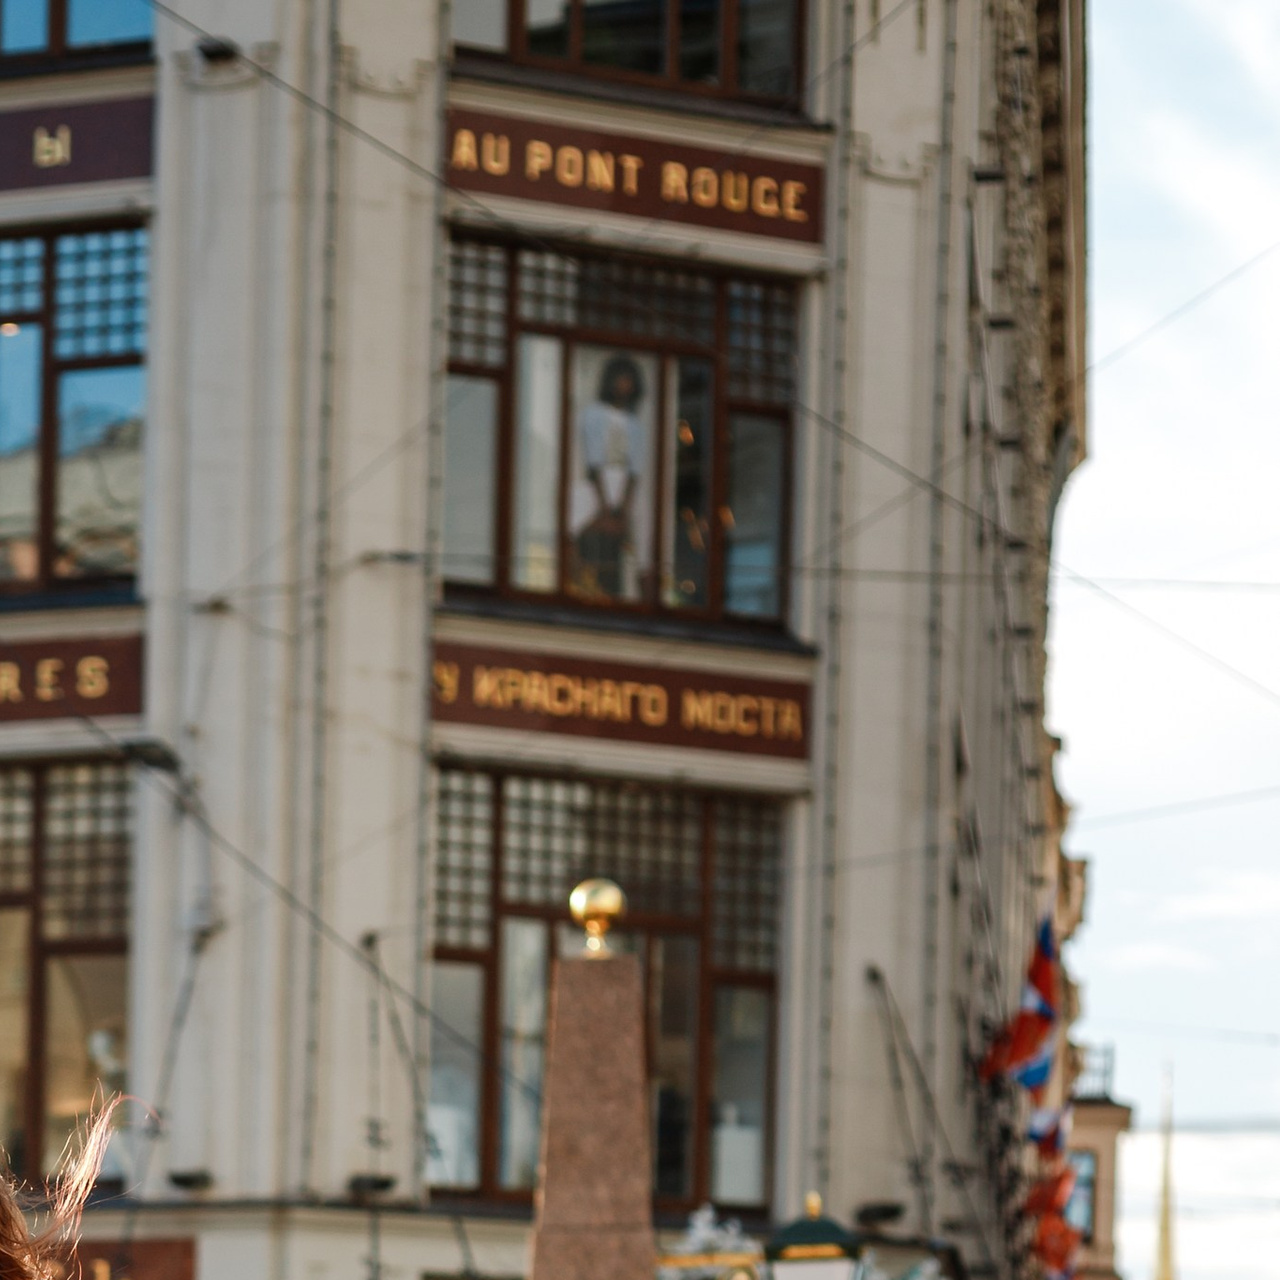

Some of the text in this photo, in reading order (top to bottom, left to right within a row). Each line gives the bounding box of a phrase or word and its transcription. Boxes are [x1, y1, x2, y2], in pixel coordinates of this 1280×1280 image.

[452, 128, 809, 223] AU PONT ROUGE
[681, 689, 803, 742] МОСТА
